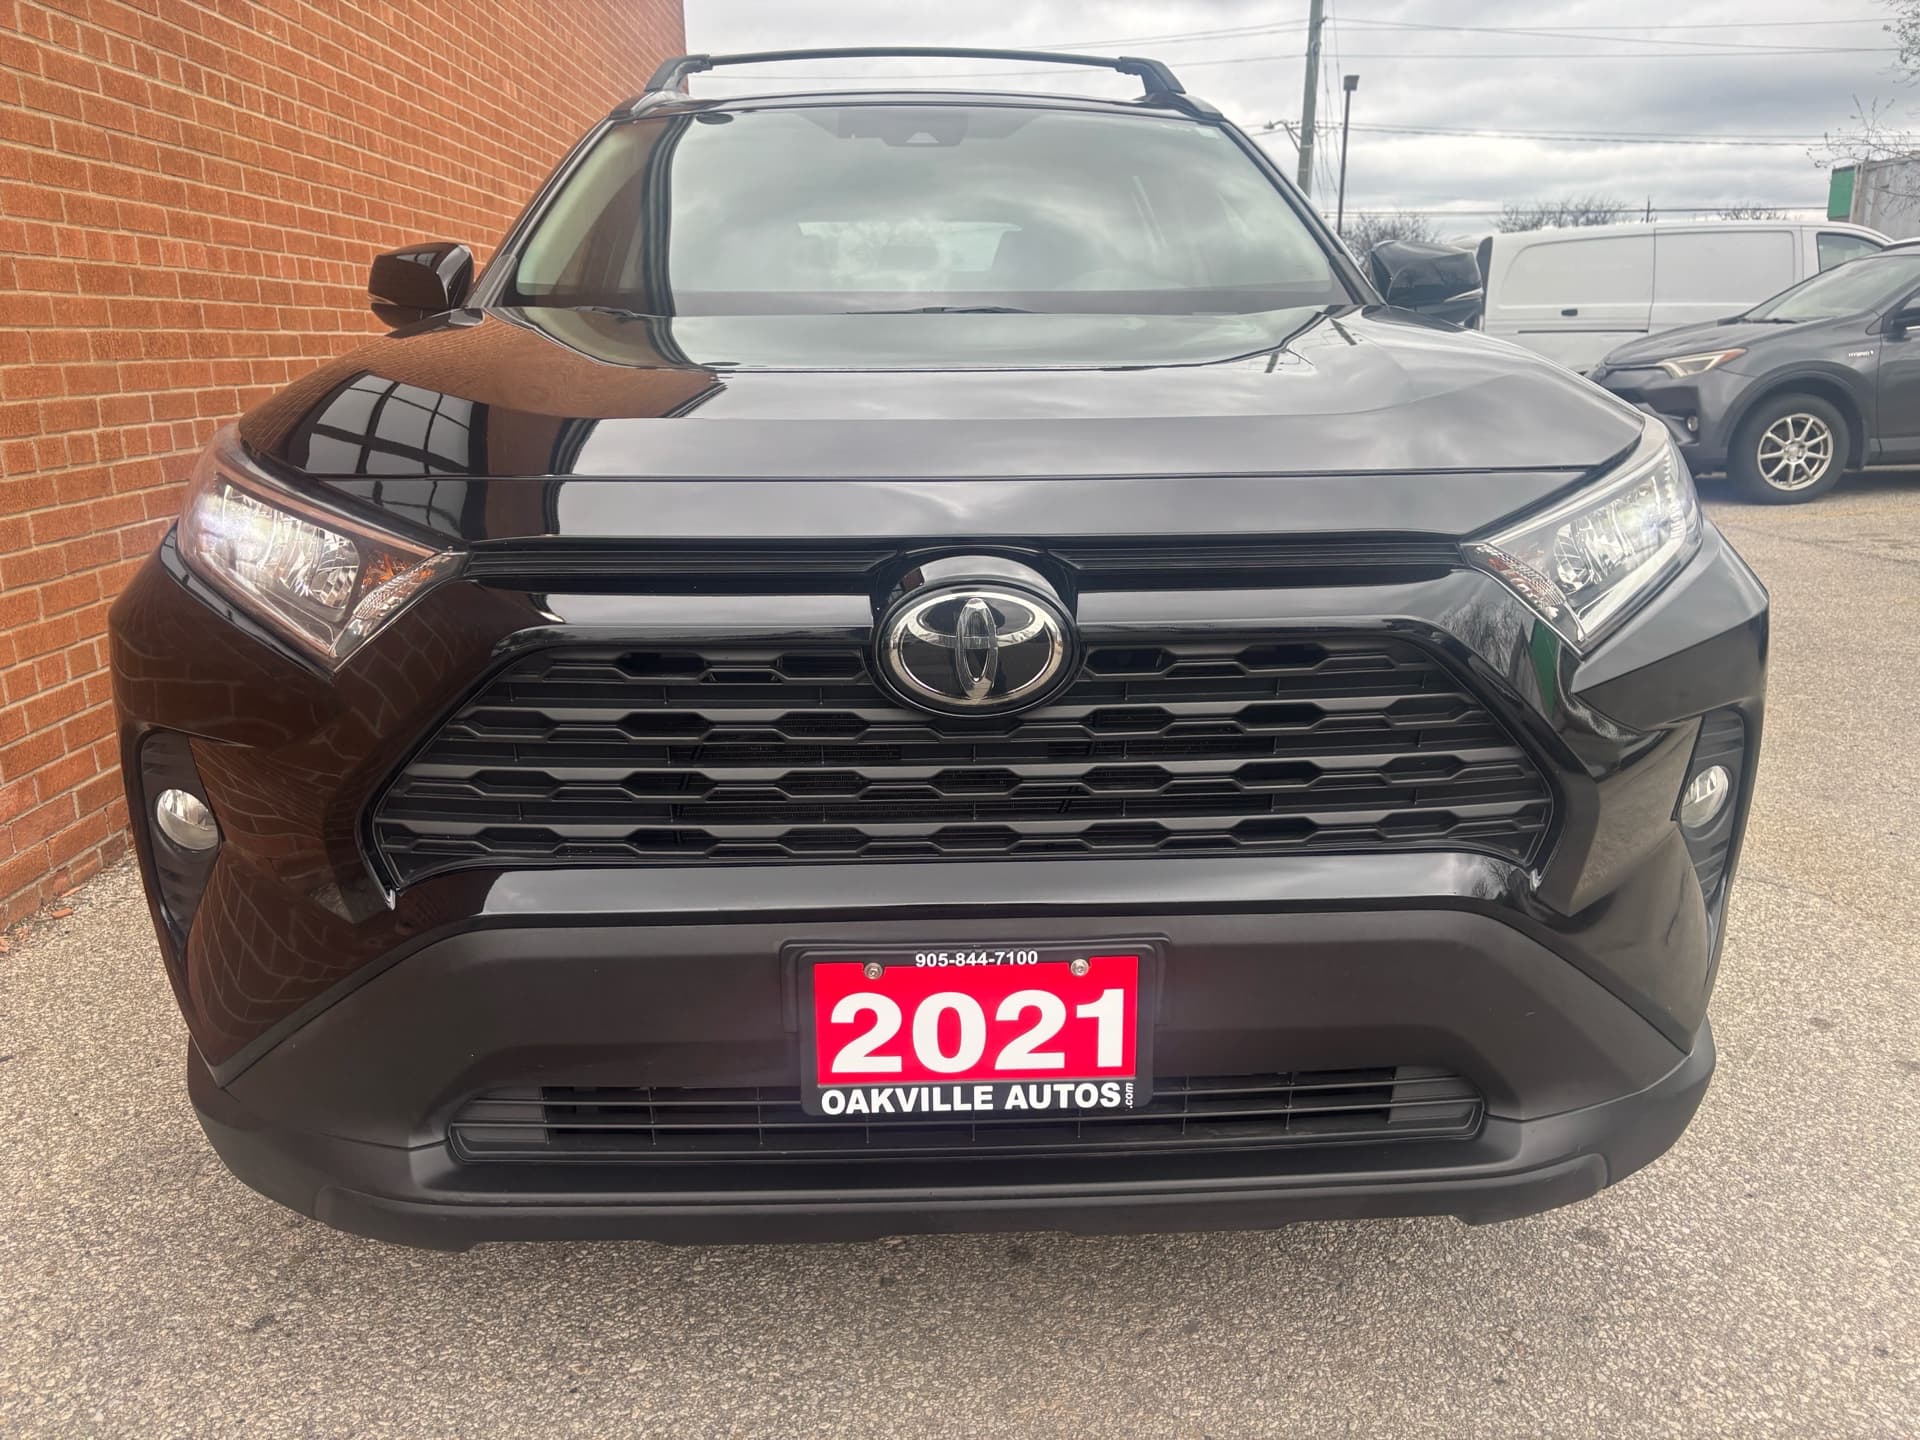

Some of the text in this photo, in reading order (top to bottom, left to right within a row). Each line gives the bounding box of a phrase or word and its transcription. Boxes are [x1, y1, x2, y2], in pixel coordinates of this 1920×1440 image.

[915, 950, 1039, 968] 905-844-7100
[830, 988, 1125, 1073] 2021
[821, 1082, 1122, 1115] OAKVILLE AUTOS
[1125, 1082, 1134, 1109] .com
